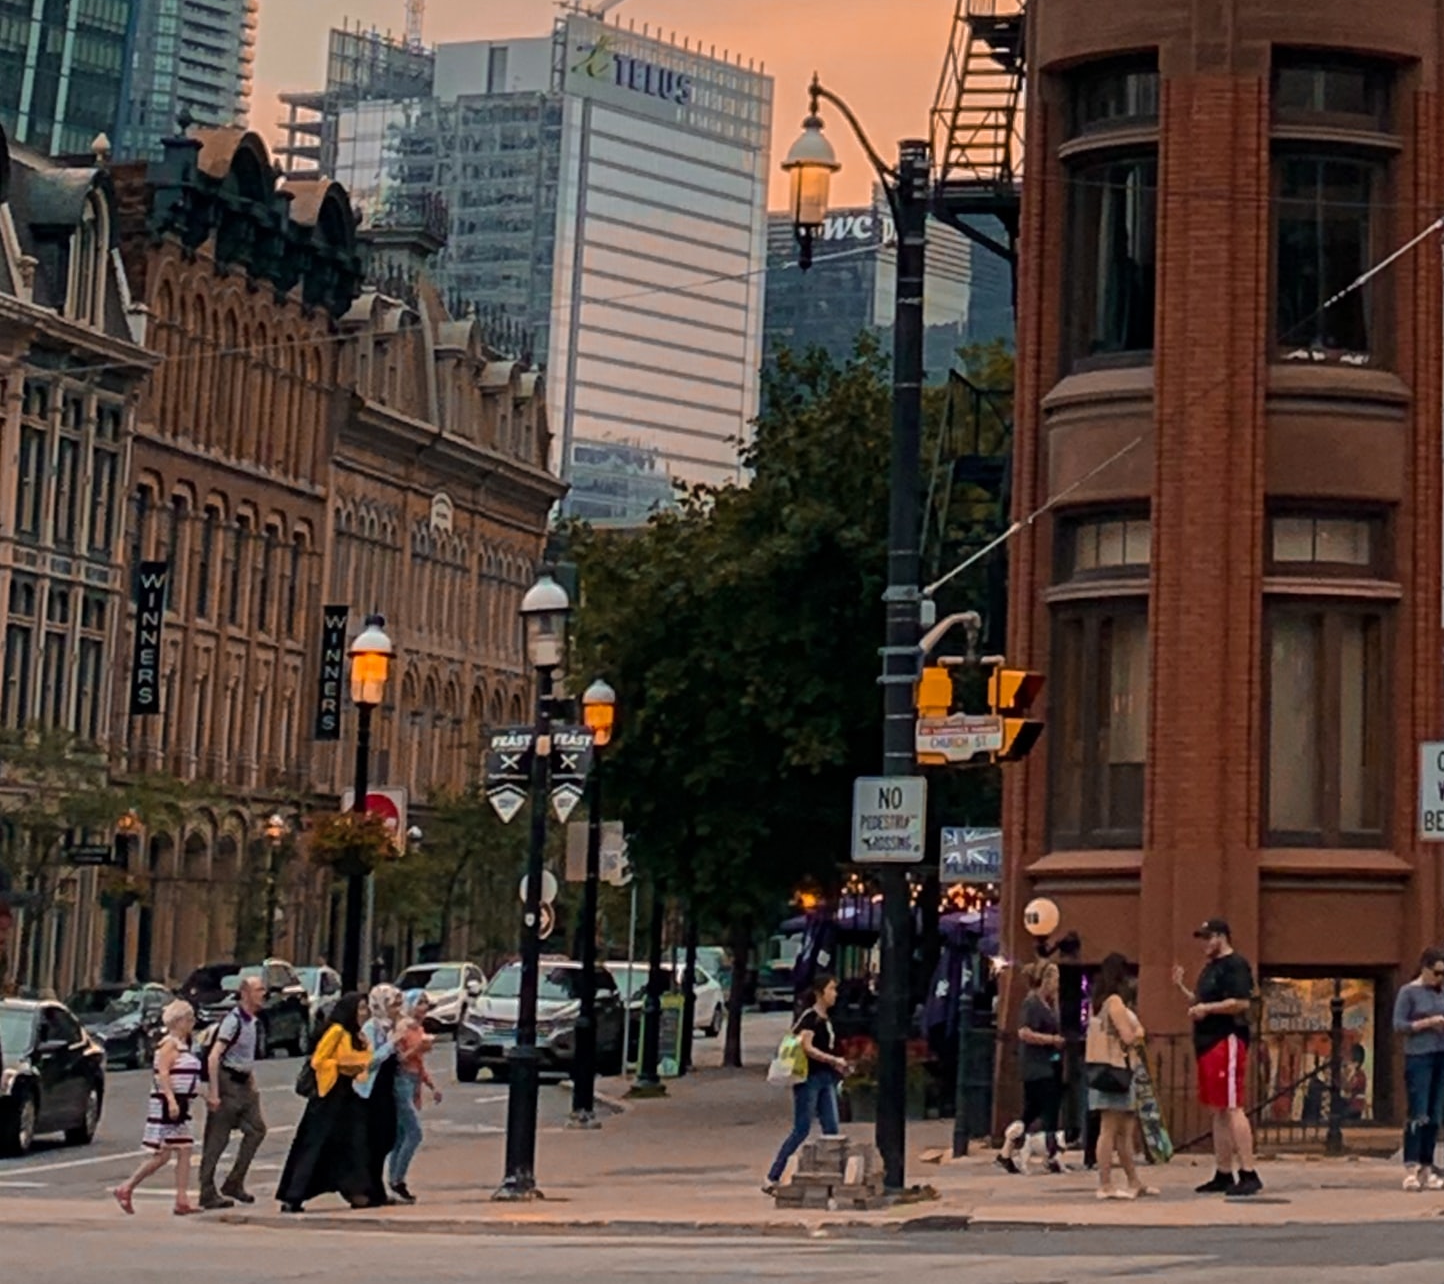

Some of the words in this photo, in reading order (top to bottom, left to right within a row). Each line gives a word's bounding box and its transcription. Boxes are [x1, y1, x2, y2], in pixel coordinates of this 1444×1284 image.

[613, 53, 691, 106] TELUS
[802, 215, 872, 241] wc
[138, 573, 166, 704] WINNERS
[321, 615, 347, 731] WINNERS
[491, 734, 532, 749] FEAST
[554, 733, 592, 747] FEAST
[878, 787, 903, 810] NO
